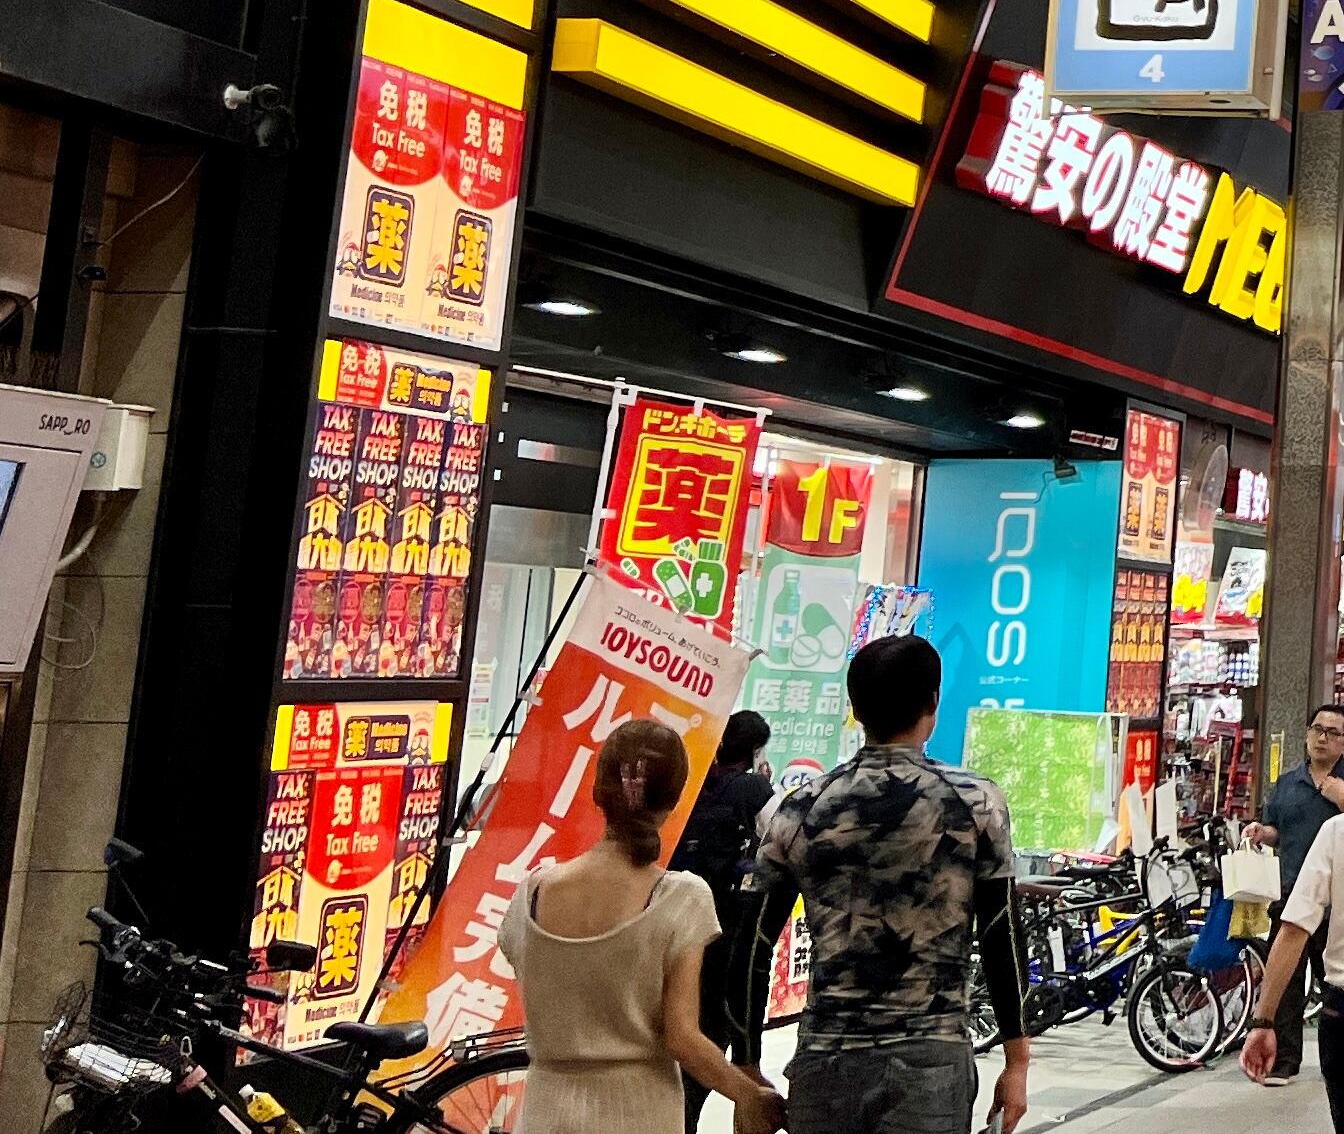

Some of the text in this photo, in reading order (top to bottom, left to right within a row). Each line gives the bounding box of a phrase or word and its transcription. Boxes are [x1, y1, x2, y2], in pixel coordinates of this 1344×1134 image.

[1138, 53, 1166, 84] 4
[372, 122, 426, 158] Tax Free
[460, 148, 502, 183] Tax Free
[366, 198, 408, 275] 薬
[451, 222, 488, 295] 薬
[314, 432, 355, 457] FREE
[361, 436, 401, 462] FREE
[407, 442, 442, 467] FREE
[308, 456, 352, 481] SHOP
[444, 447, 482, 472] FREE
[355, 461, 399, 485] SHOP
[402, 467, 438, 491] SHO
[439, 470, 480, 494] SHOP
[631, 447, 738, 544] 薬
[797, 466, 861, 544] 1F
[752, 677, 842, 717] 医薬品
[267, 803, 308, 827] FREE
[331, 783, 382, 828] 免税
[404, 792, 439, 816] FREE
[260, 826, 308, 854] SHOP
[399, 817, 439, 841] SHOP
[326, 831, 379, 857] Tax Free
[320, 907, 363, 988] 薬
